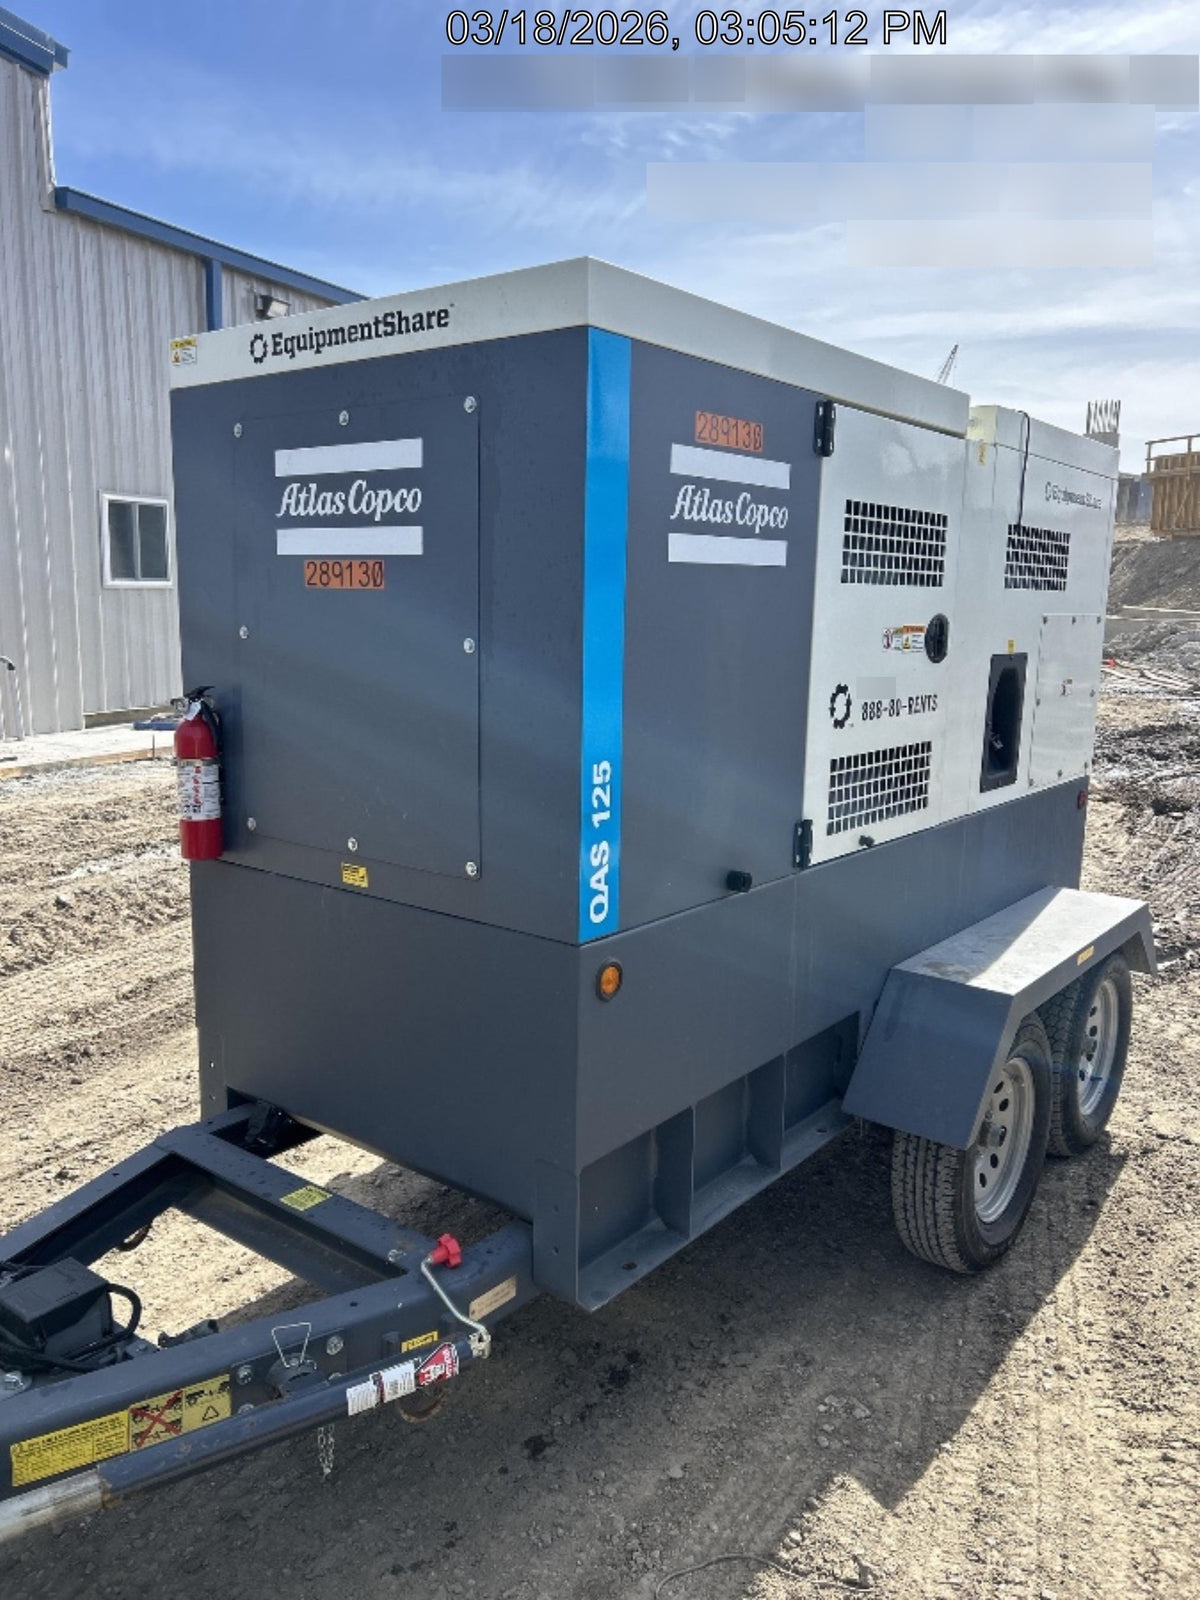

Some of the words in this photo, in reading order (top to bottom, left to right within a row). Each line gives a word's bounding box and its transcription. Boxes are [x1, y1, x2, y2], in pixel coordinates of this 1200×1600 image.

[271, 308, 450, 360] EquipmentShare
[697, 413, 763, 451] 289130
[306, 561, 383, 588] 289130
[861, 694, 938, 721] 888-80-RENTS
[592, 760, 612, 829] 125
[590, 840, 610, 924] QAS
